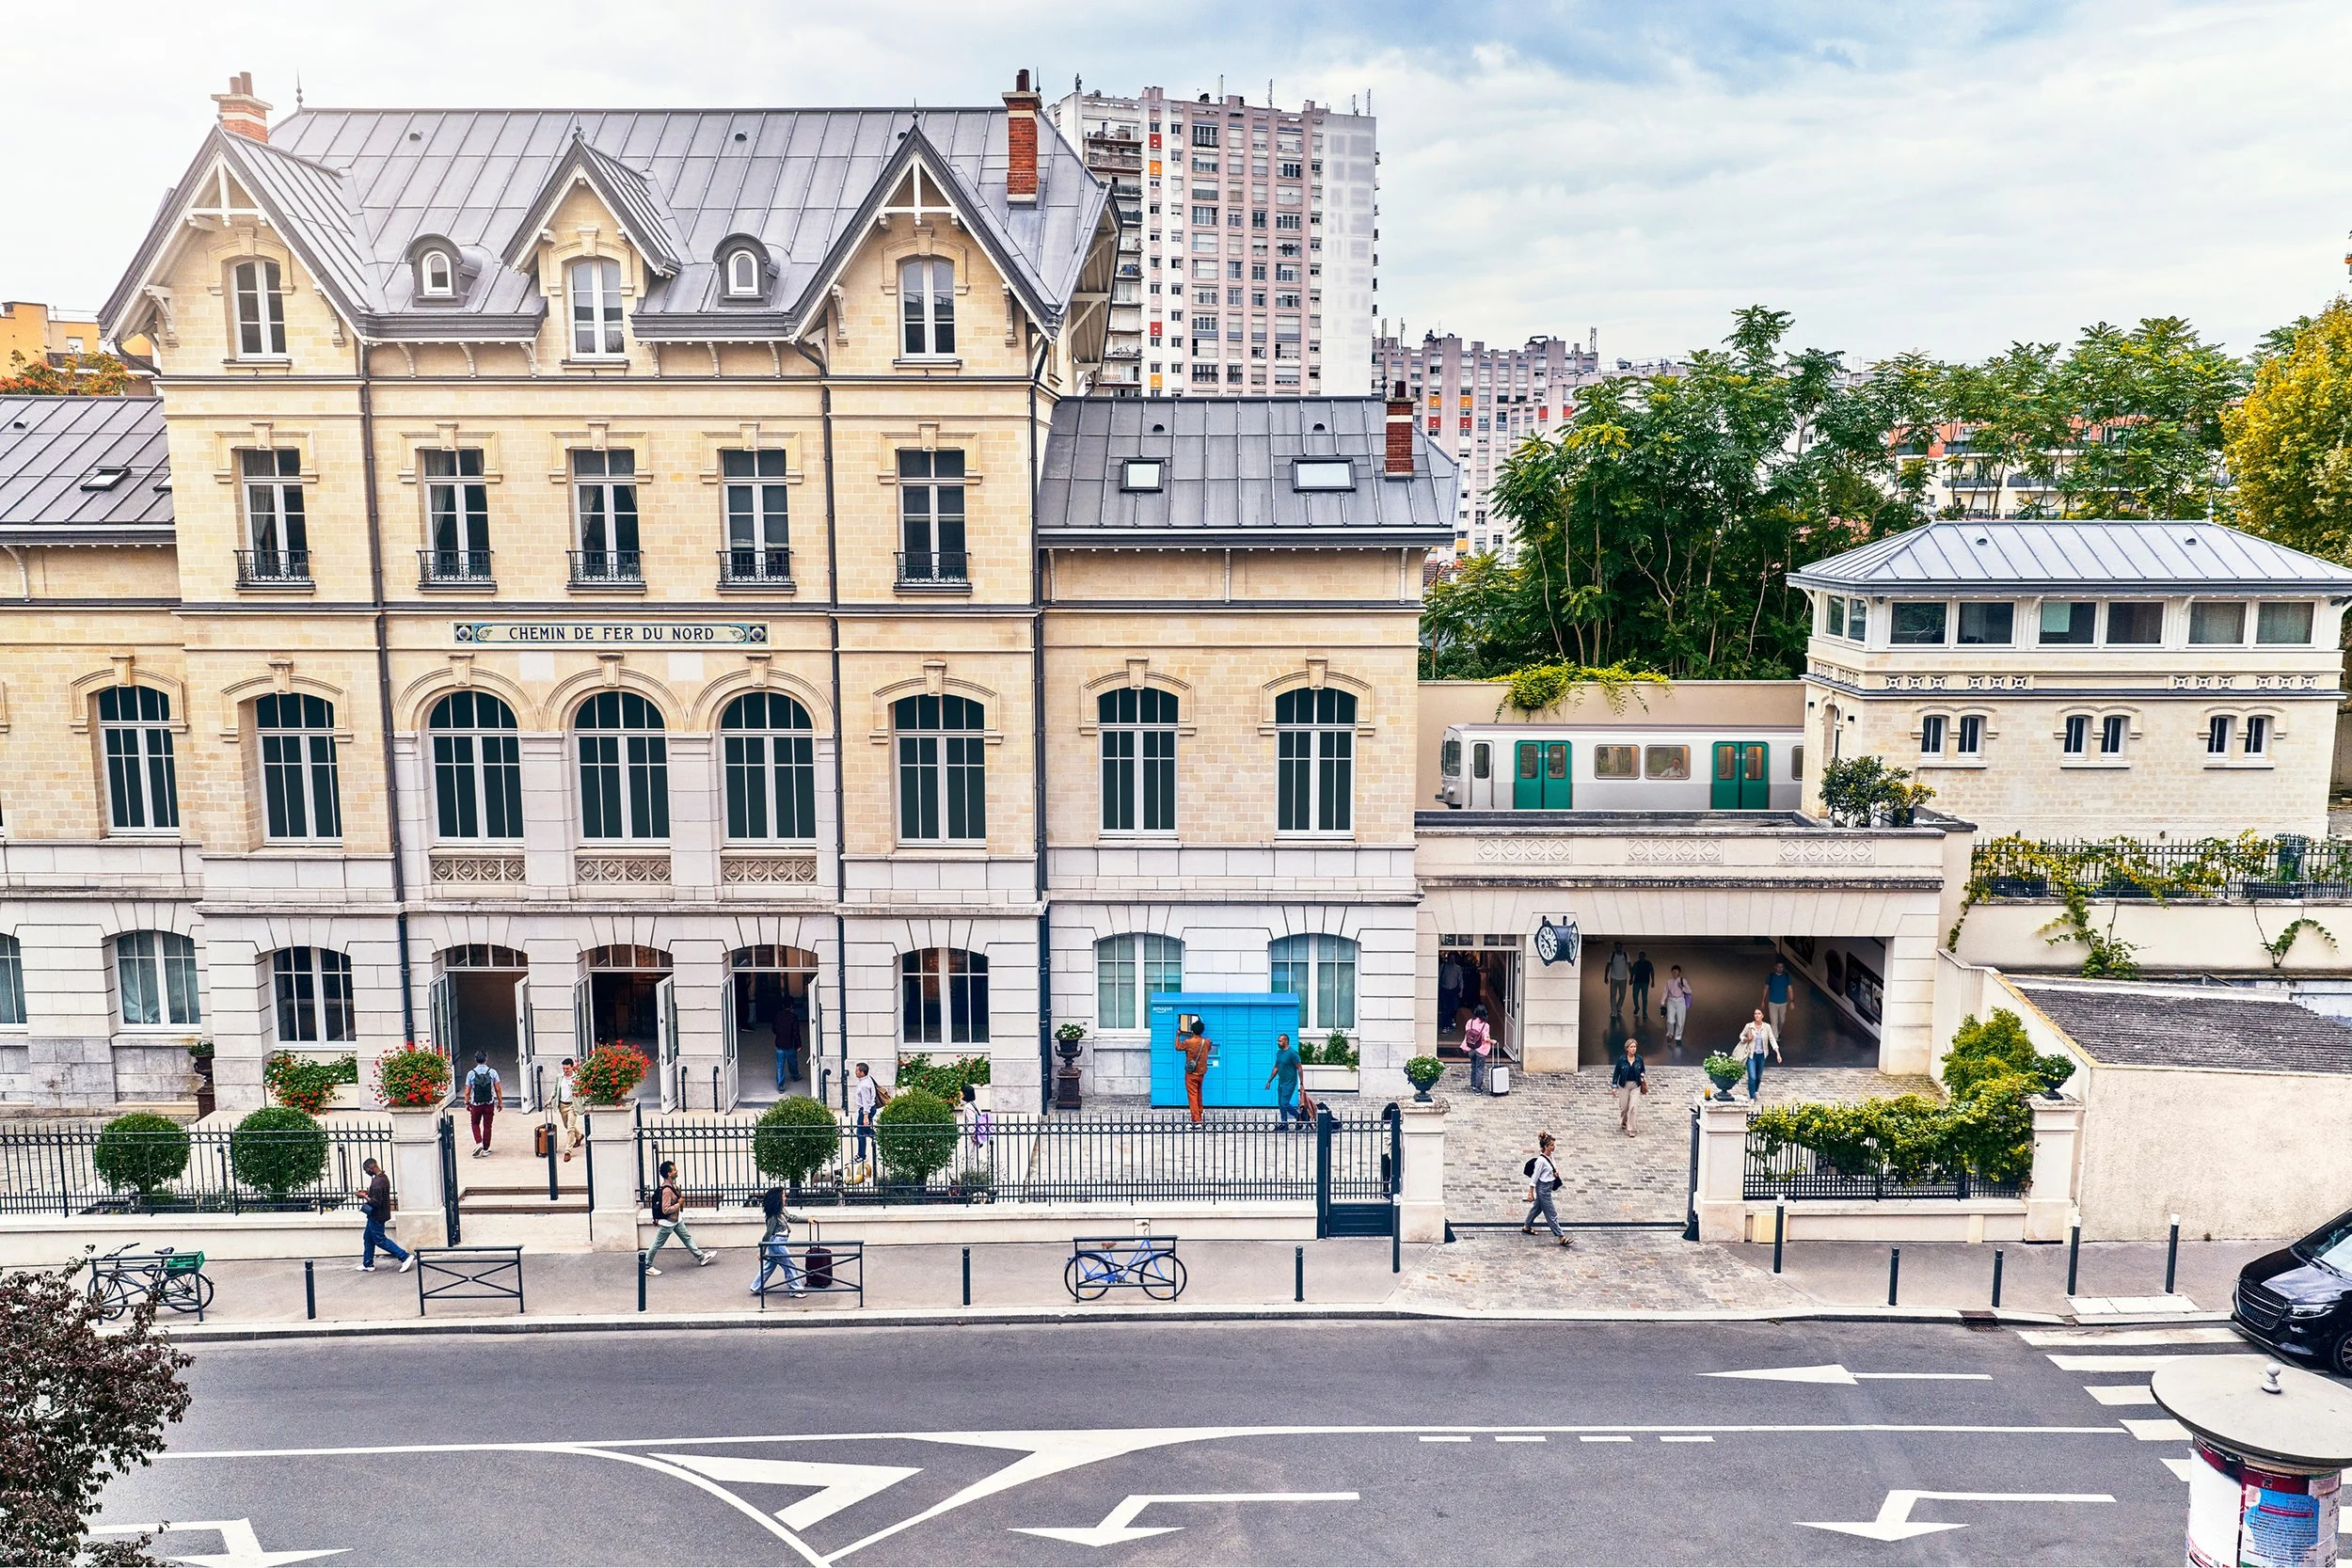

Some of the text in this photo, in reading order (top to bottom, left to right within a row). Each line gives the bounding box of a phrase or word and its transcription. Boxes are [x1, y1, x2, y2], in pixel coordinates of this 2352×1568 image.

[509, 626, 714, 641] CHEMIN DE FER DU NORD
